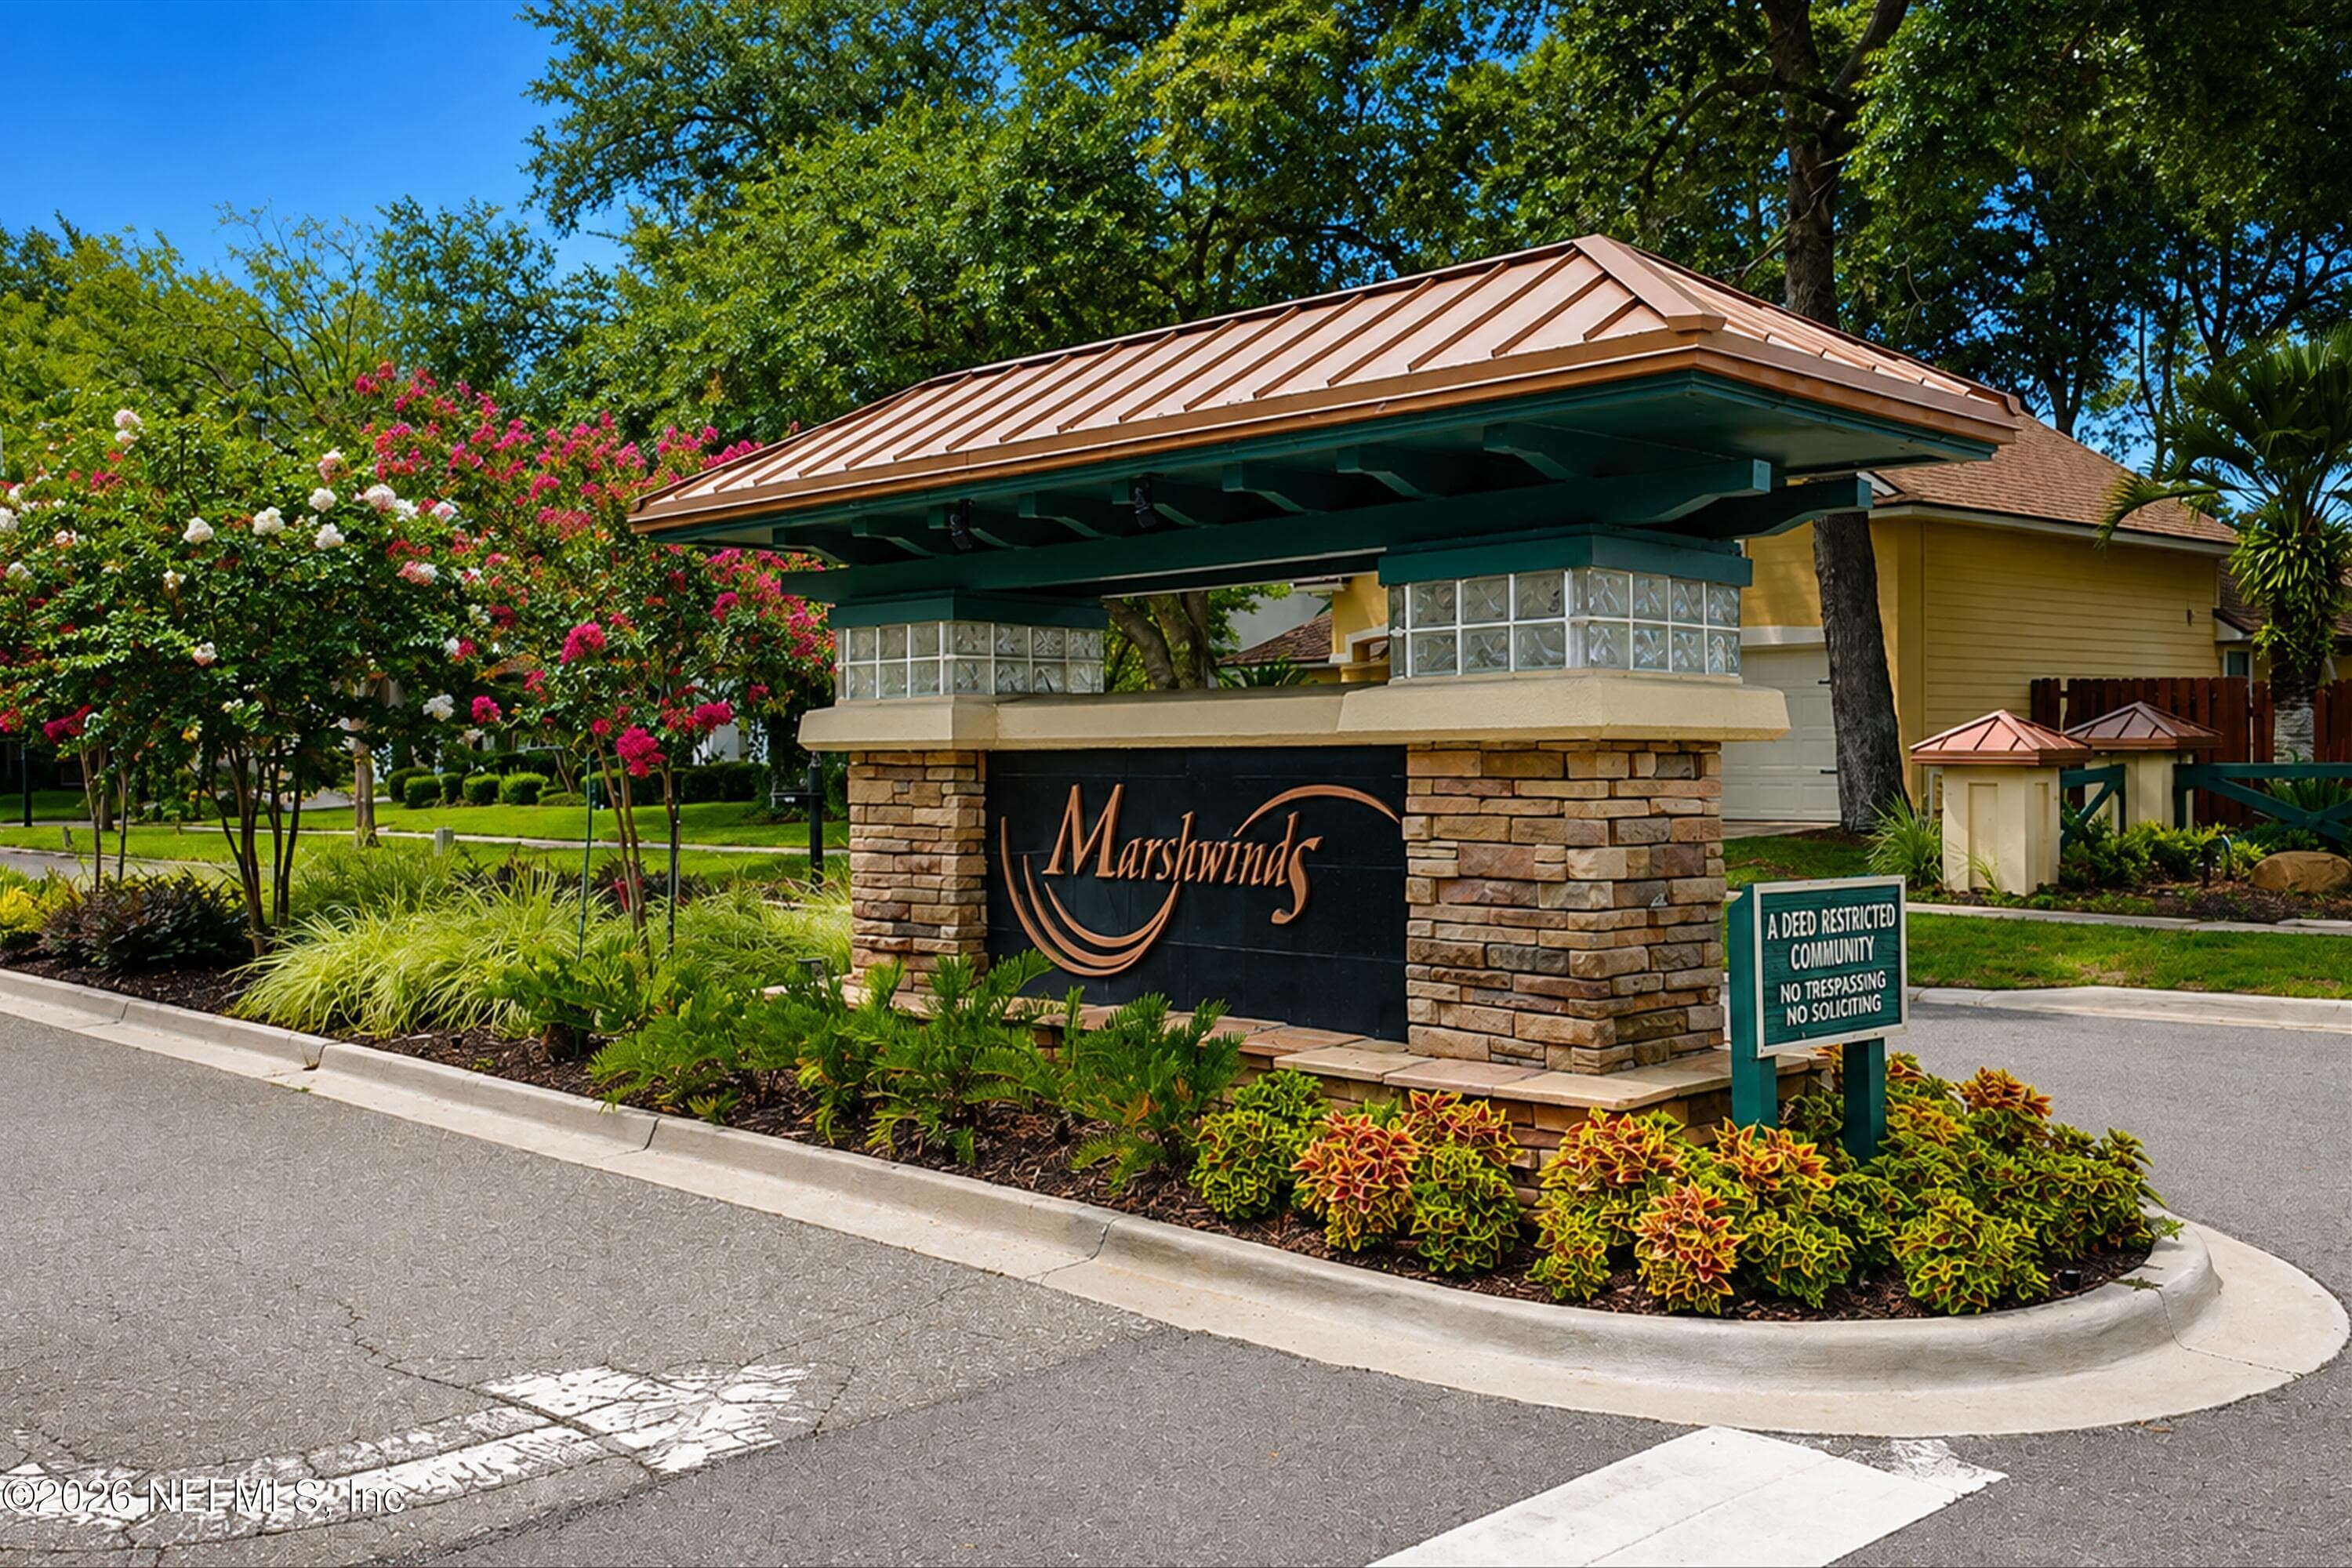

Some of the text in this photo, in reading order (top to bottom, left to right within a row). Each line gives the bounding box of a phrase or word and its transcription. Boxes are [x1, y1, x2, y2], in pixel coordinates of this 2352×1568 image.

[1042, 783, 1324, 925] Marshwinds
[1767, 903, 1896, 940] A DEED RESTRICTED
[1791, 935, 1875, 970] COMMUNITY
[1780, 971, 1886, 1004] NO TRESPASSING
[1786, 994, 1882, 1027] NO SOLICITING
